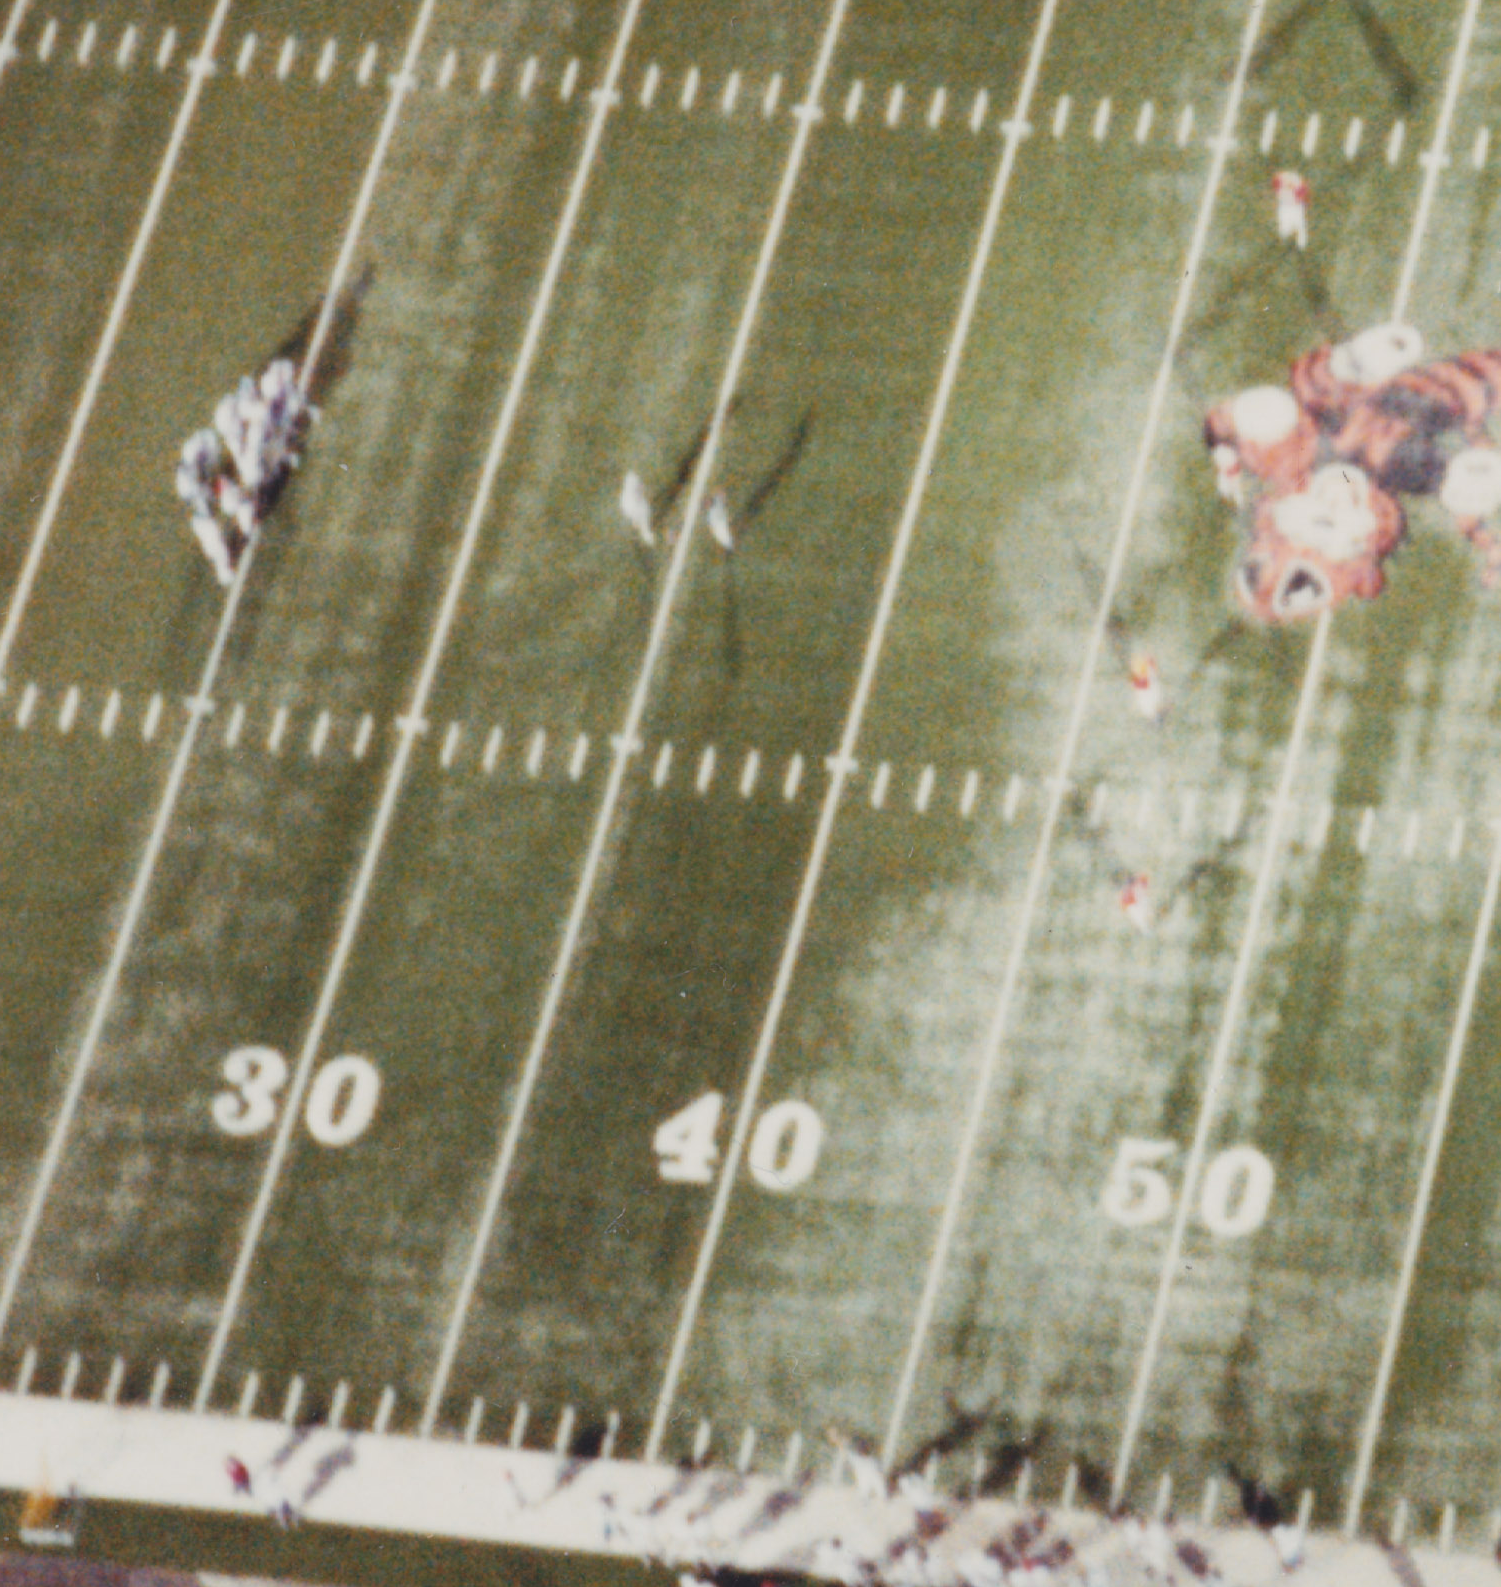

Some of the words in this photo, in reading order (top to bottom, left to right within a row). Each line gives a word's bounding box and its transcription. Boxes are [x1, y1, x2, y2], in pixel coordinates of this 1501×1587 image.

[210, 1045, 381, 1146] 30
[651, 1091, 824, 1192] 40
[1101, 1139, 1275, 1238] 50
